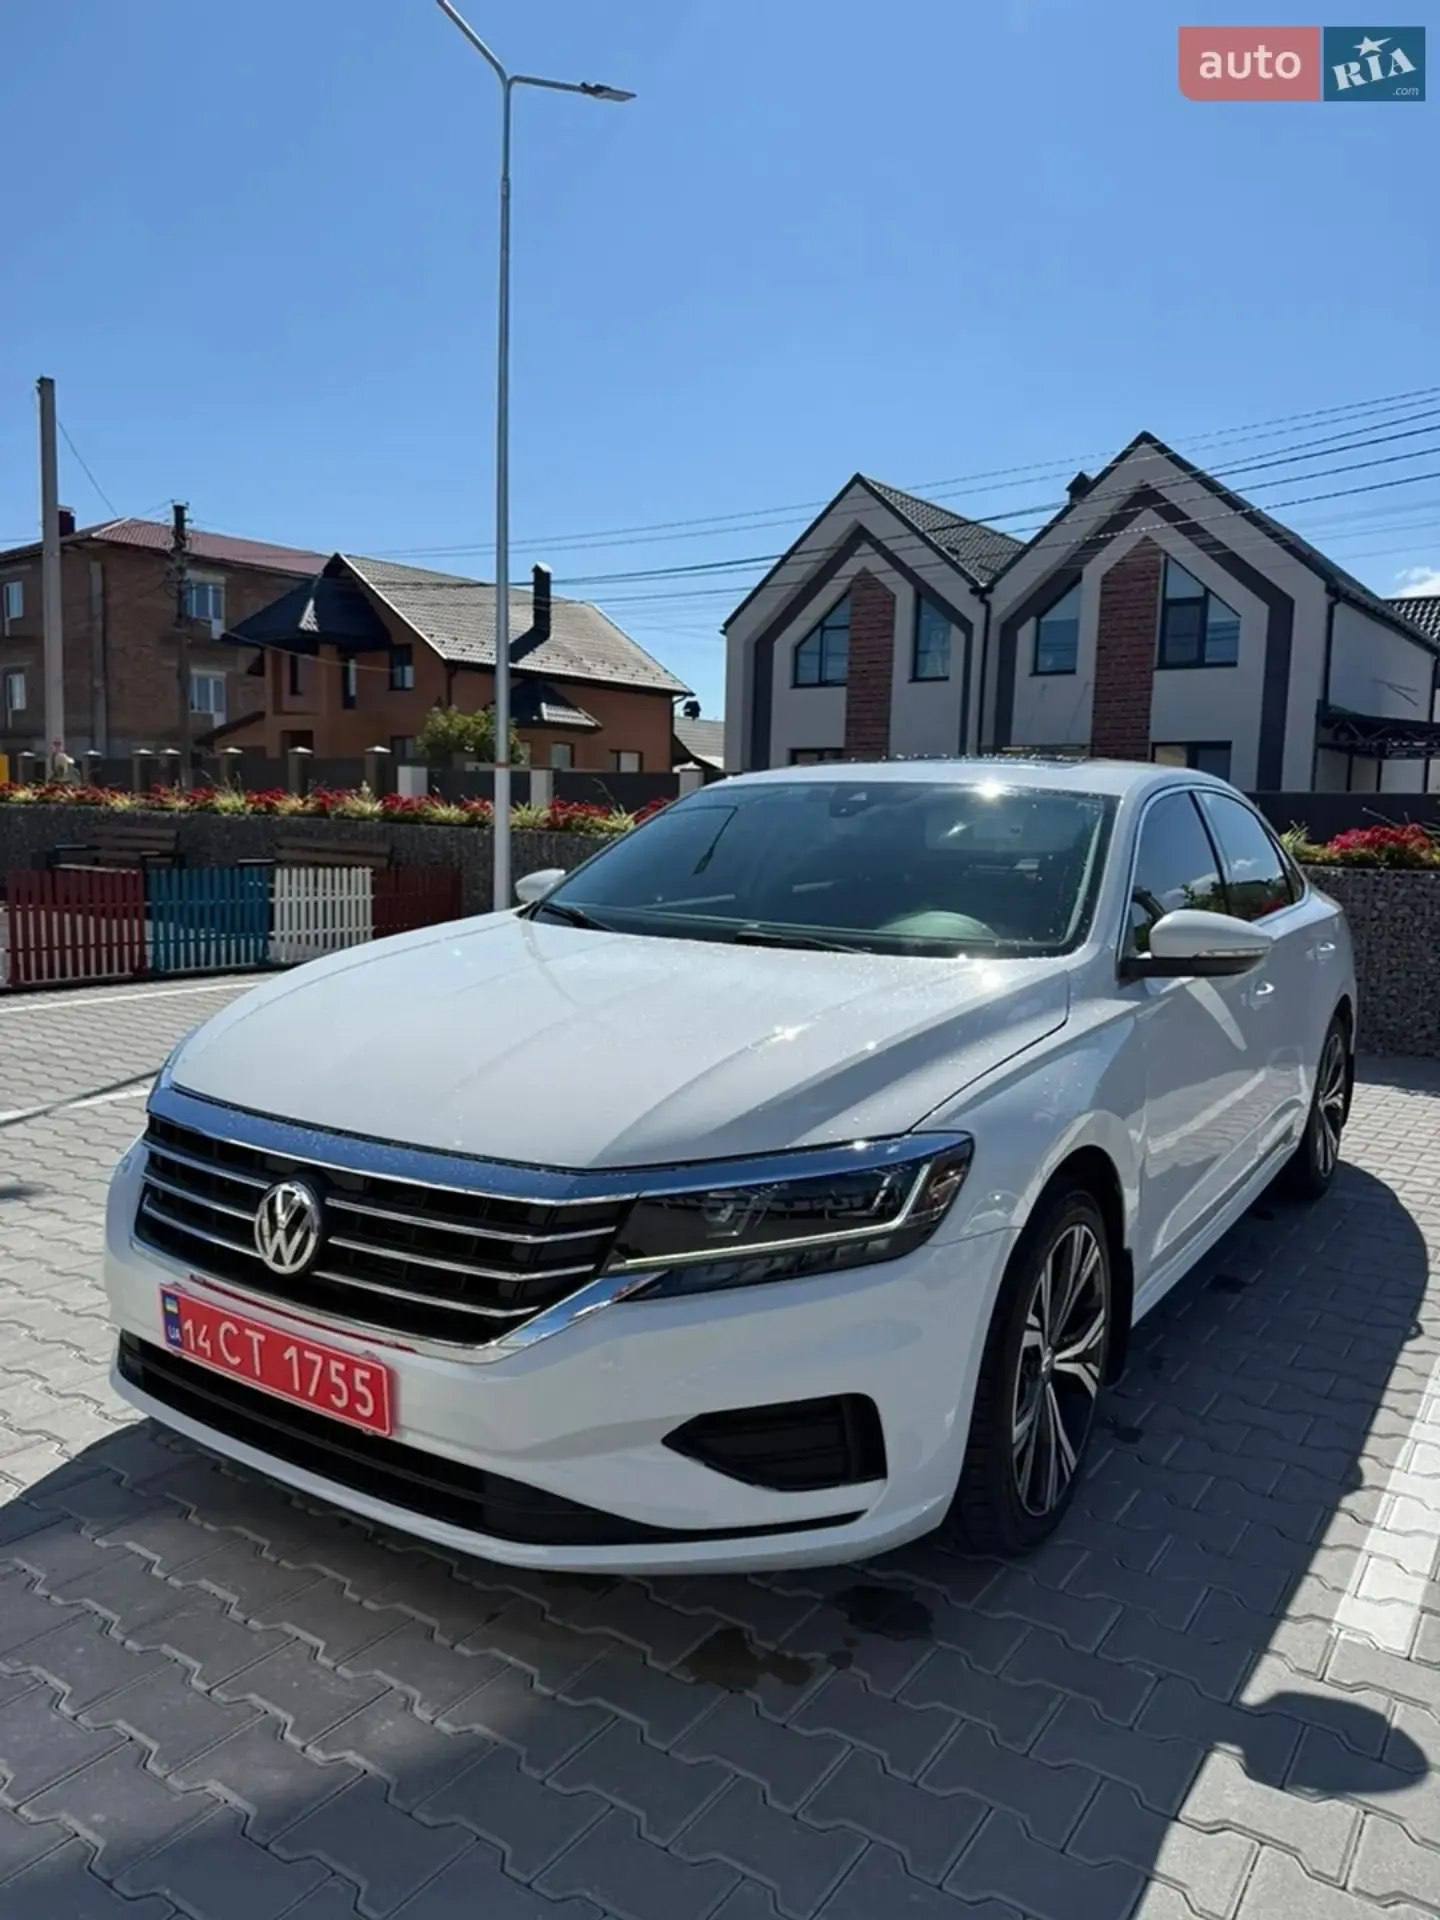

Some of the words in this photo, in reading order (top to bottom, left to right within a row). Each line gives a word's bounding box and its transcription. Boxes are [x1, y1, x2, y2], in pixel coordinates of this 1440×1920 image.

[256, 1183, 318, 1273] VW
[167, 1325, 181, 1342] UA
[283, 1345, 374, 1417] 1755
